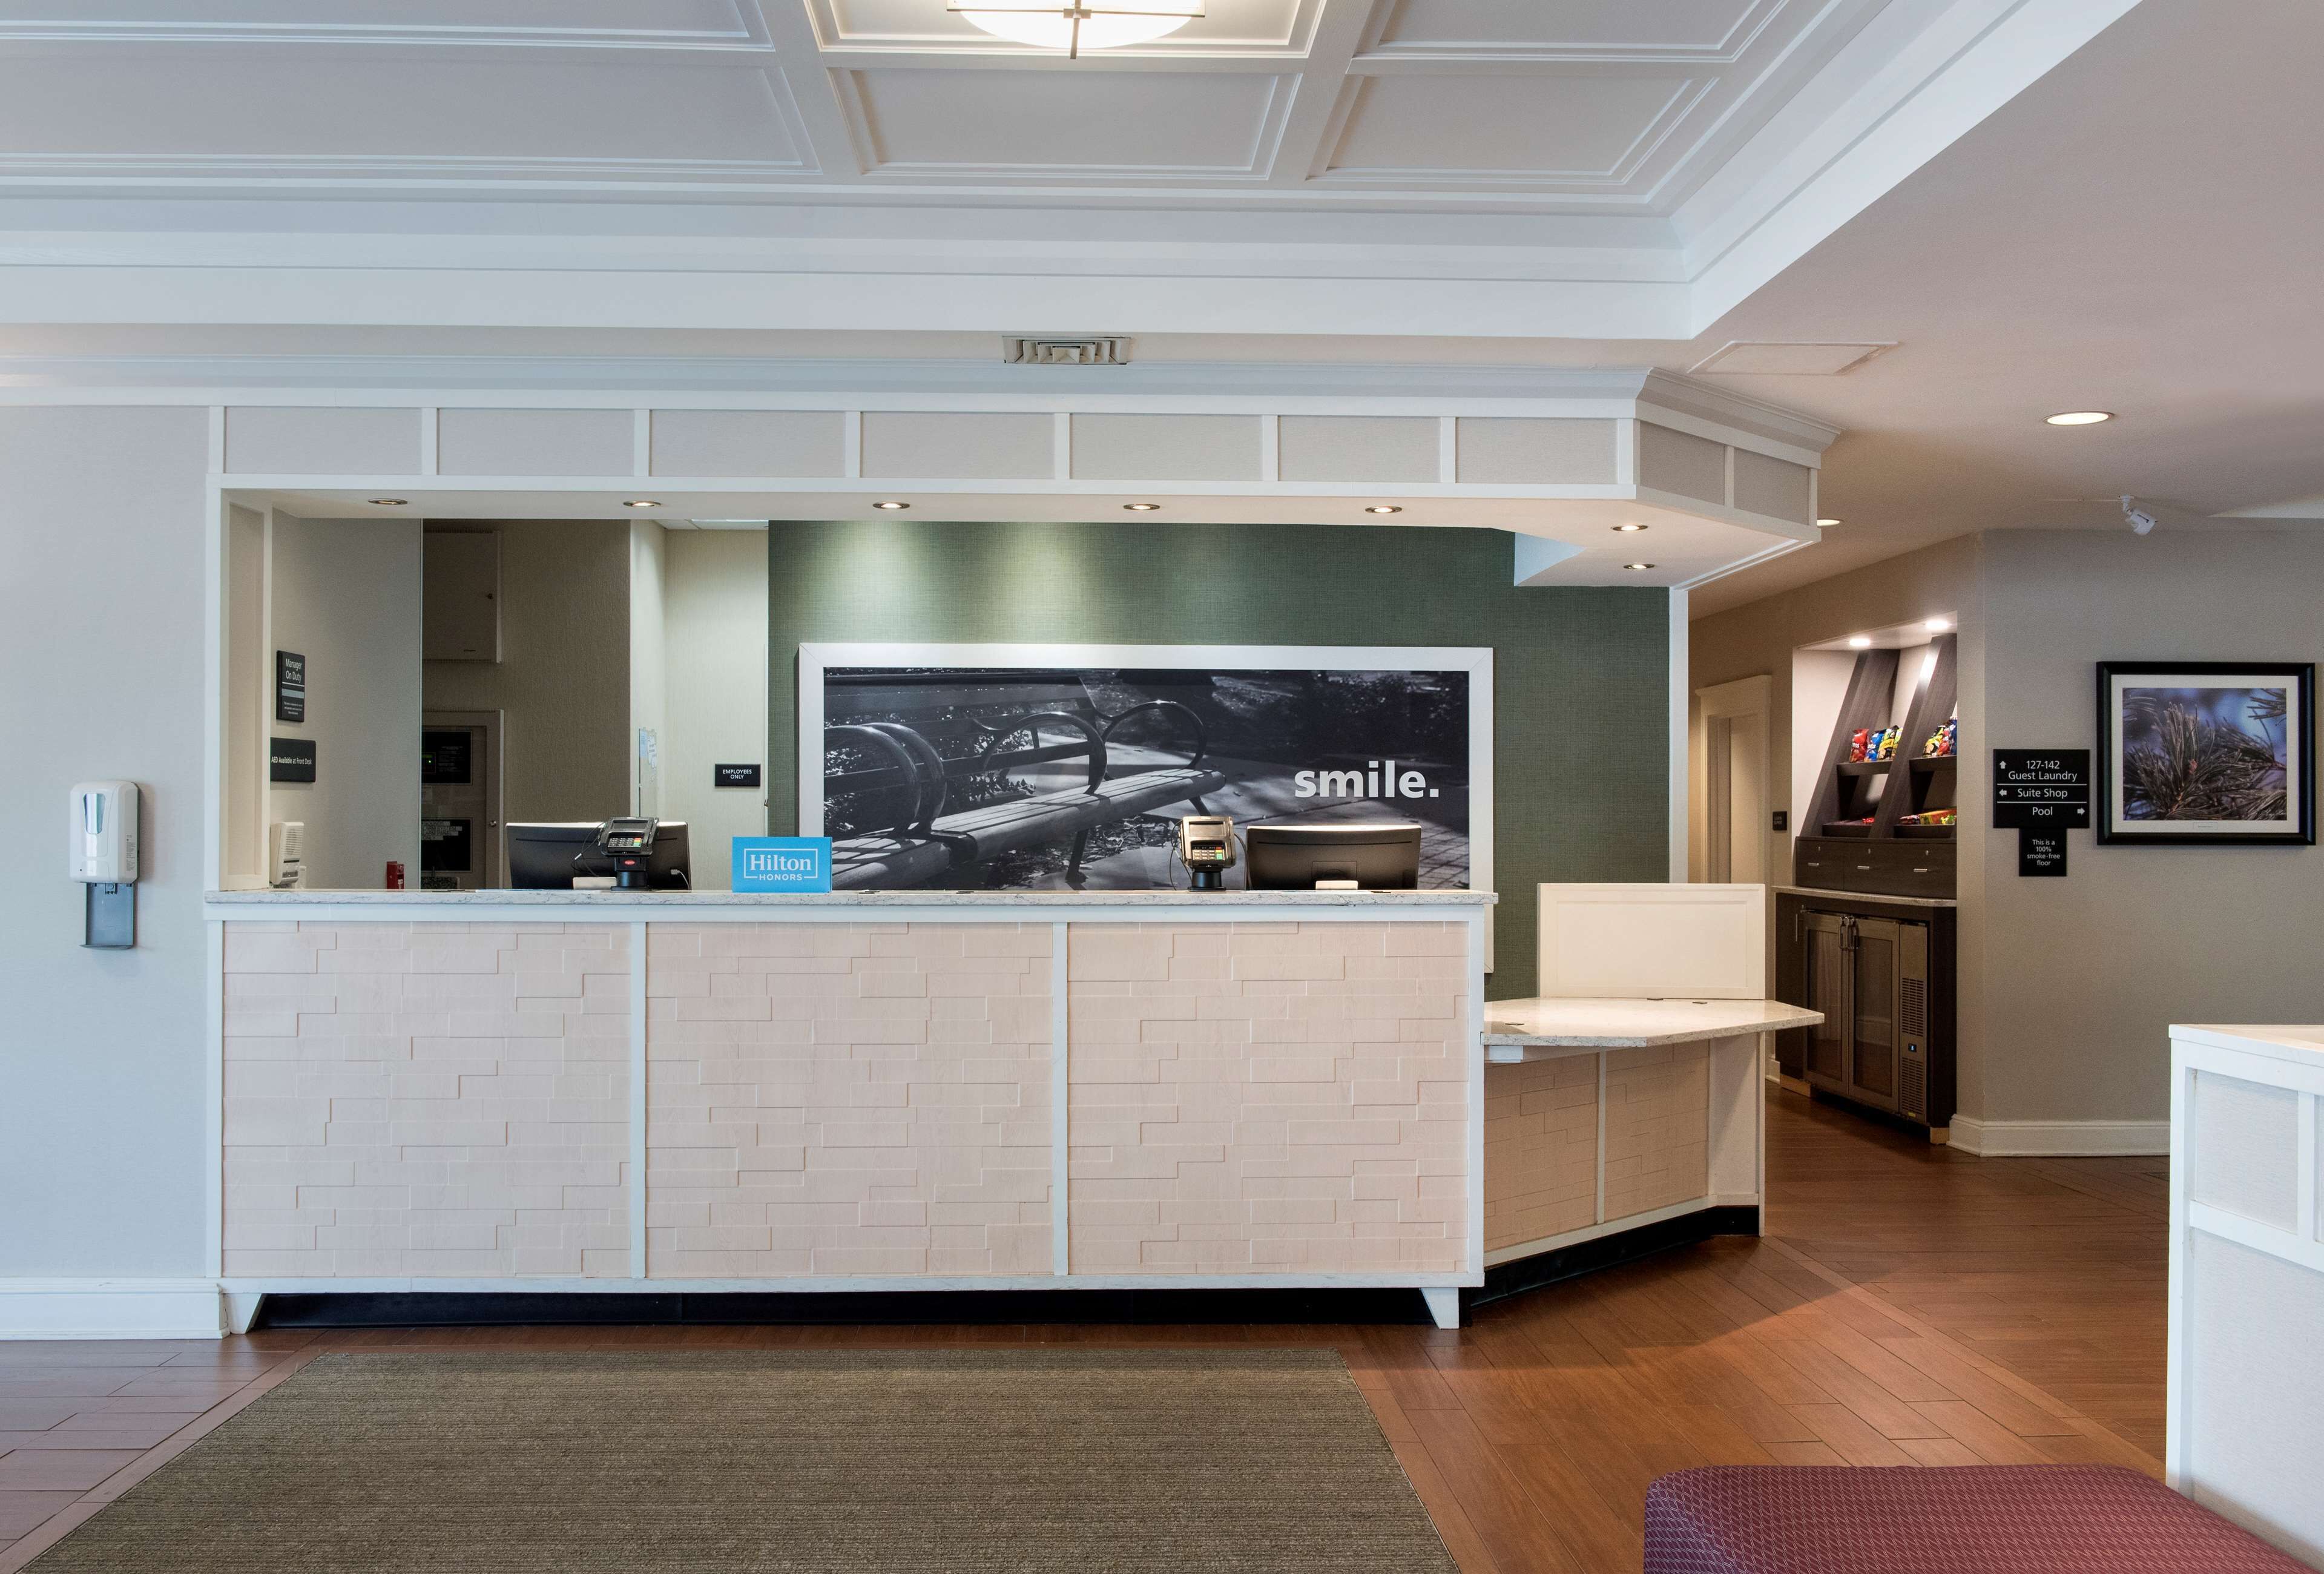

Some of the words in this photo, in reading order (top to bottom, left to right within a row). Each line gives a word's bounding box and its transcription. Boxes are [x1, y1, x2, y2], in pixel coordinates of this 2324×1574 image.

[285, 658, 303, 671] Manager
[286, 670, 292, 679] On
[292, 671, 301, 683] Duty
[2026, 760, 2060, 769] 127-142
[1294, 760, 1439, 799] smile.
[2008, 771, 2036, 780] Guest
[2038, 771, 2078, 782] Laundry
[2017, 788, 2041, 797] Suite
[2044, 788, 2068, 799] Shop
[2032, 806, 2053, 815] Pool
[749, 854, 812, 871] Hilton
